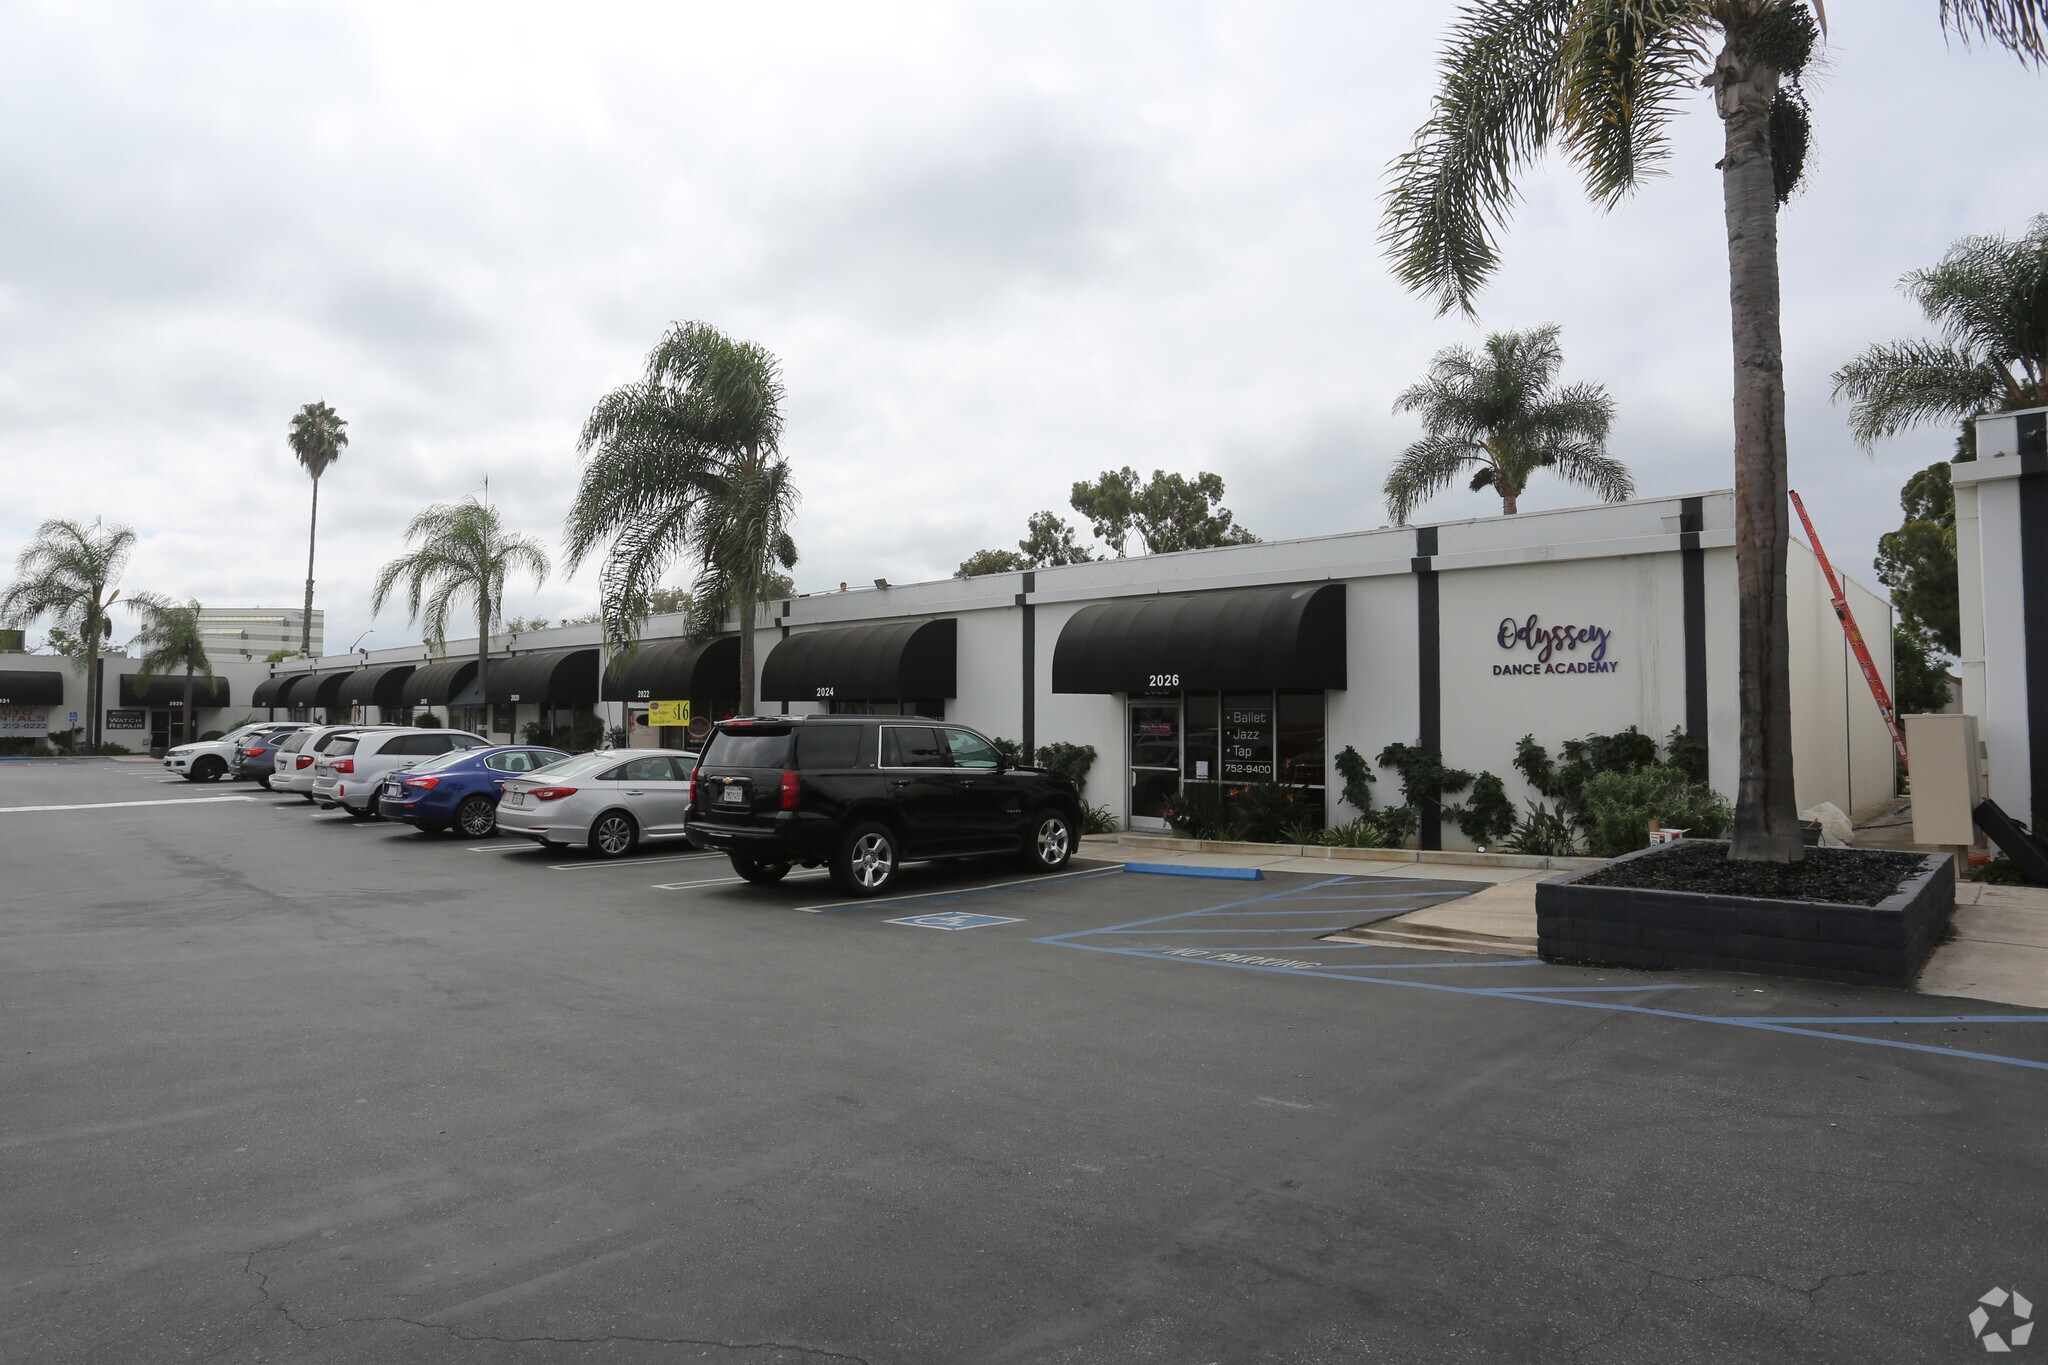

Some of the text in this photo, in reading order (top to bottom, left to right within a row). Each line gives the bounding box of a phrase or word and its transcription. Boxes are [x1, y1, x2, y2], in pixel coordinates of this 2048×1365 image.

[1497, 614, 1611, 663] Odyssey
[1493, 661, 1618, 676] DANCE ACADEMY
[1149, 673, 1180, 687] 2026
[637, 690, 650, 698] 2022
[816, 687, 834, 697] 2024
[673, 702, 689, 721] $16
[1233, 711, 1267, 723] Ballet
[1232, 728, 1260, 740] Jazz
[1232, 745, 1252, 759] Tap
[1225, 764, 1271, 774] 752-9400
[1163, 948, 1322, 969] NO PARKING
